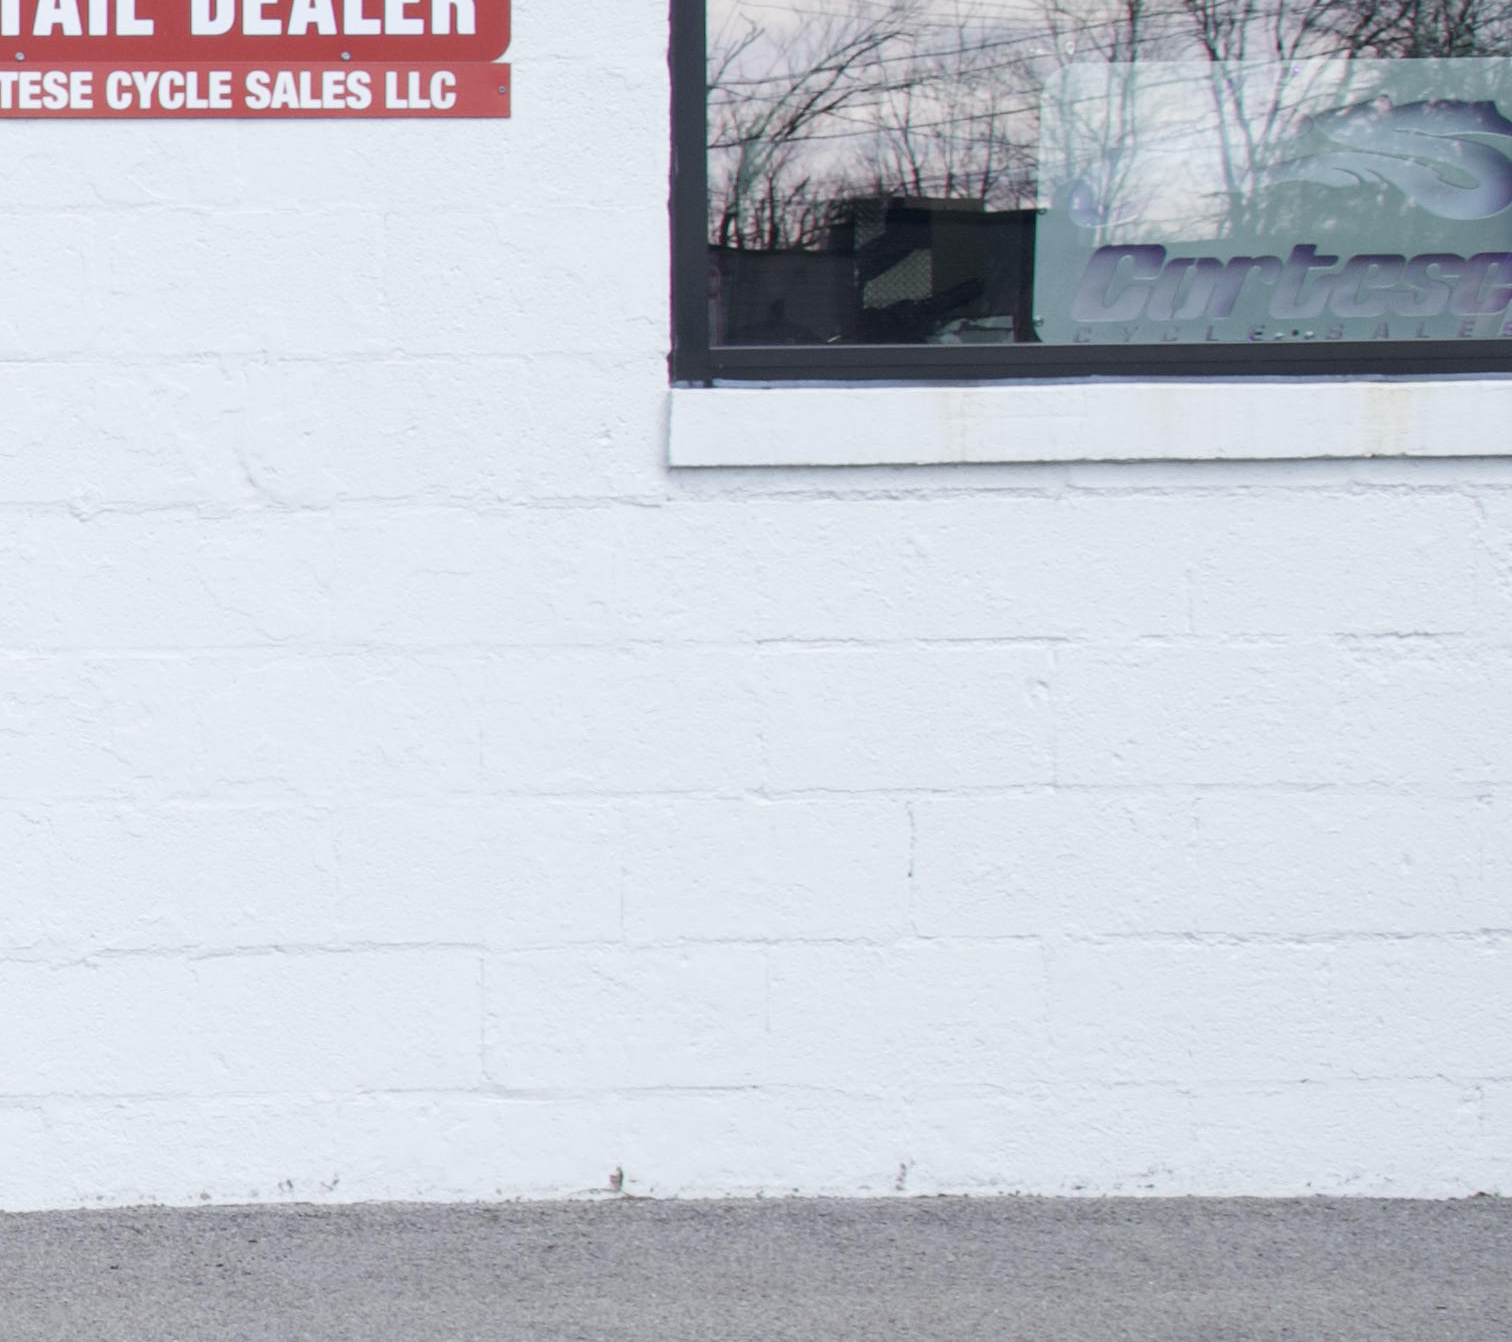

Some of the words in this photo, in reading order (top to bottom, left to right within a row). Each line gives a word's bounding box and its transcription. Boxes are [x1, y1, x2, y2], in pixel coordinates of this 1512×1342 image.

[106, 71, 232, 110] CYCLE
[245, 71, 371, 110] SALES
[385, 71, 456, 110] LLC
[1069, 244, 1512, 322] Cortese
